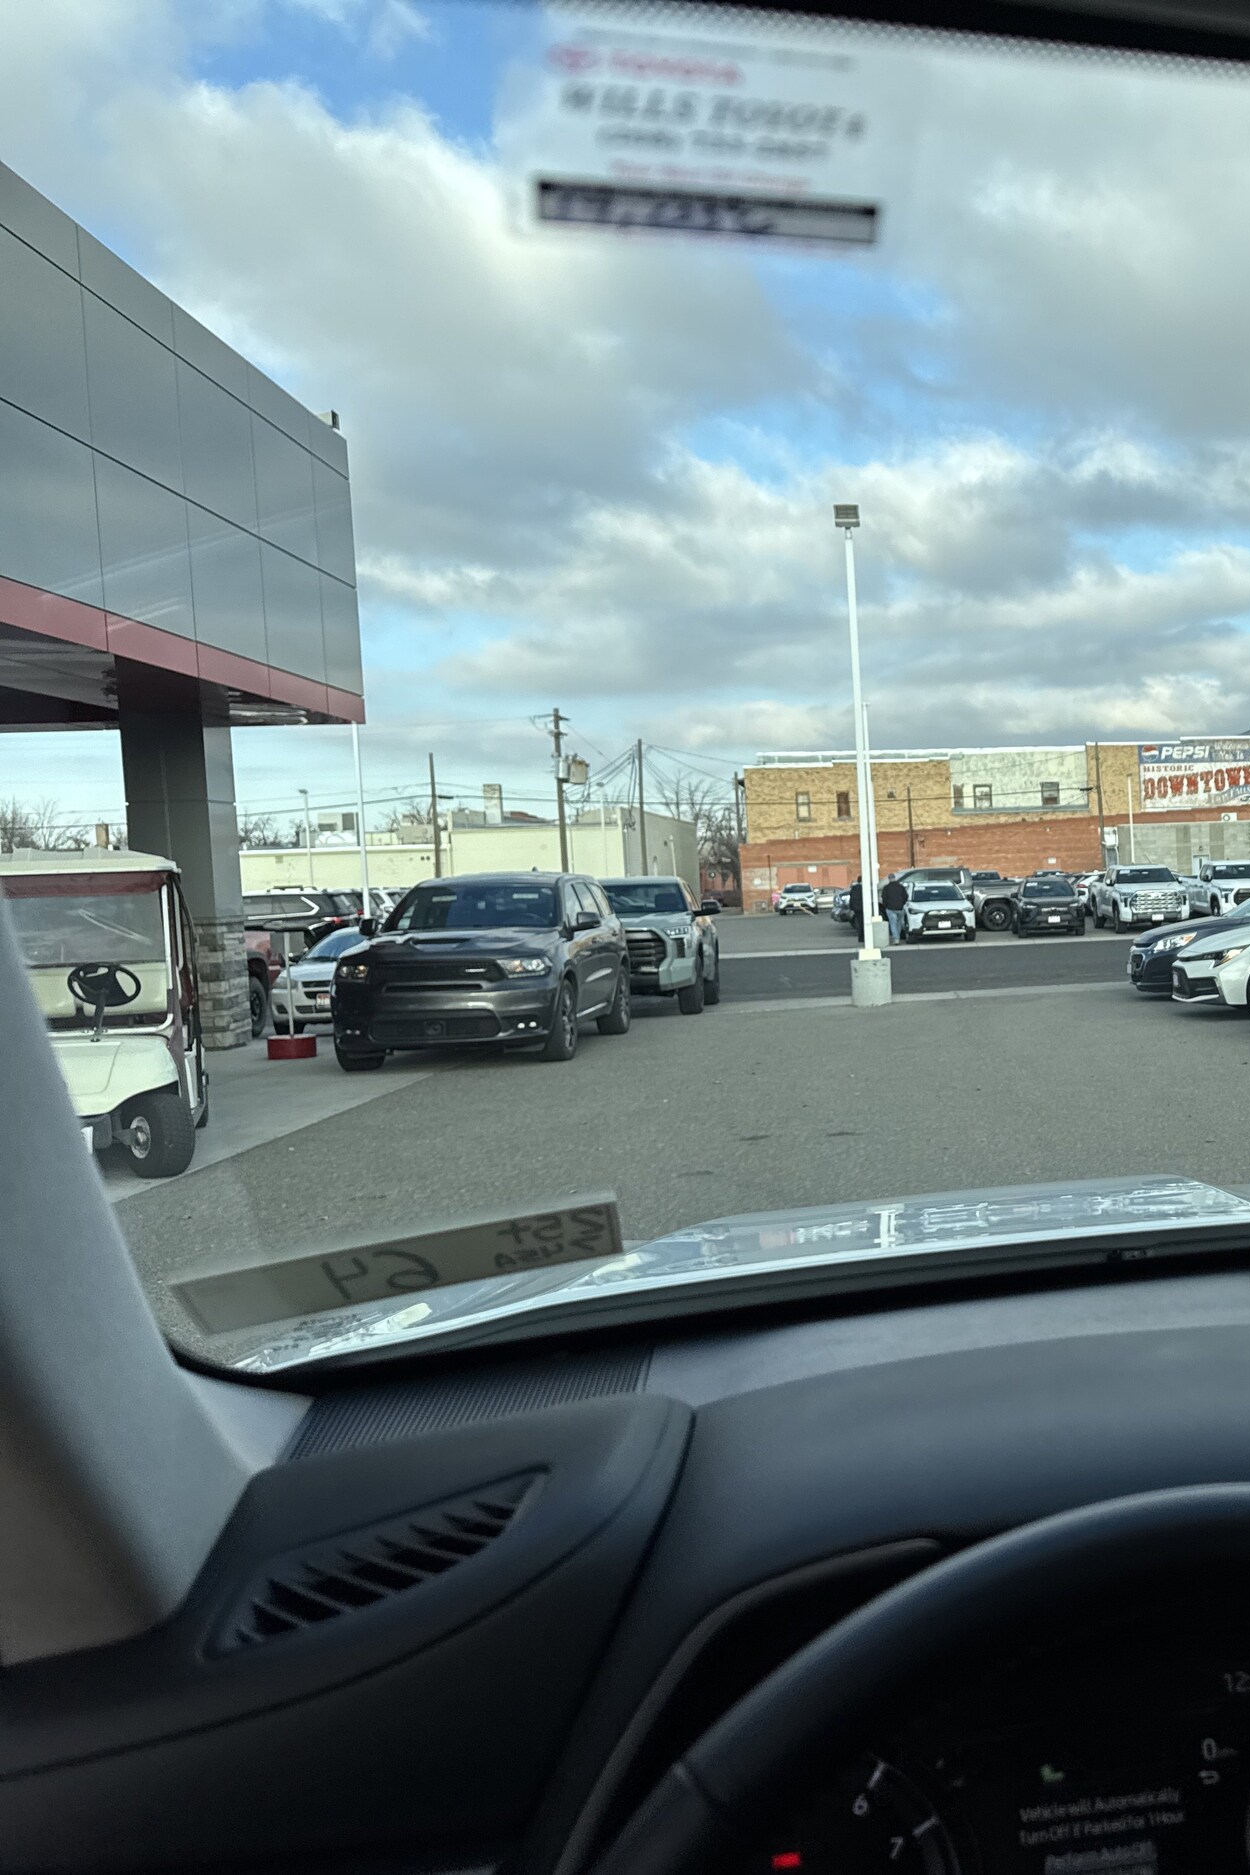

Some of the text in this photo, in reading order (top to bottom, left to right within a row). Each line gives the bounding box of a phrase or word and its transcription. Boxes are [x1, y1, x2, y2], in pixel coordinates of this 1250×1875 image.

[1160, 745, 1210, 760] PEPSI
[1143, 765, 1194, 773] HISTORIC
[852, 1793, 869, 1816] 6
[890, 1836, 904, 1861] 7
